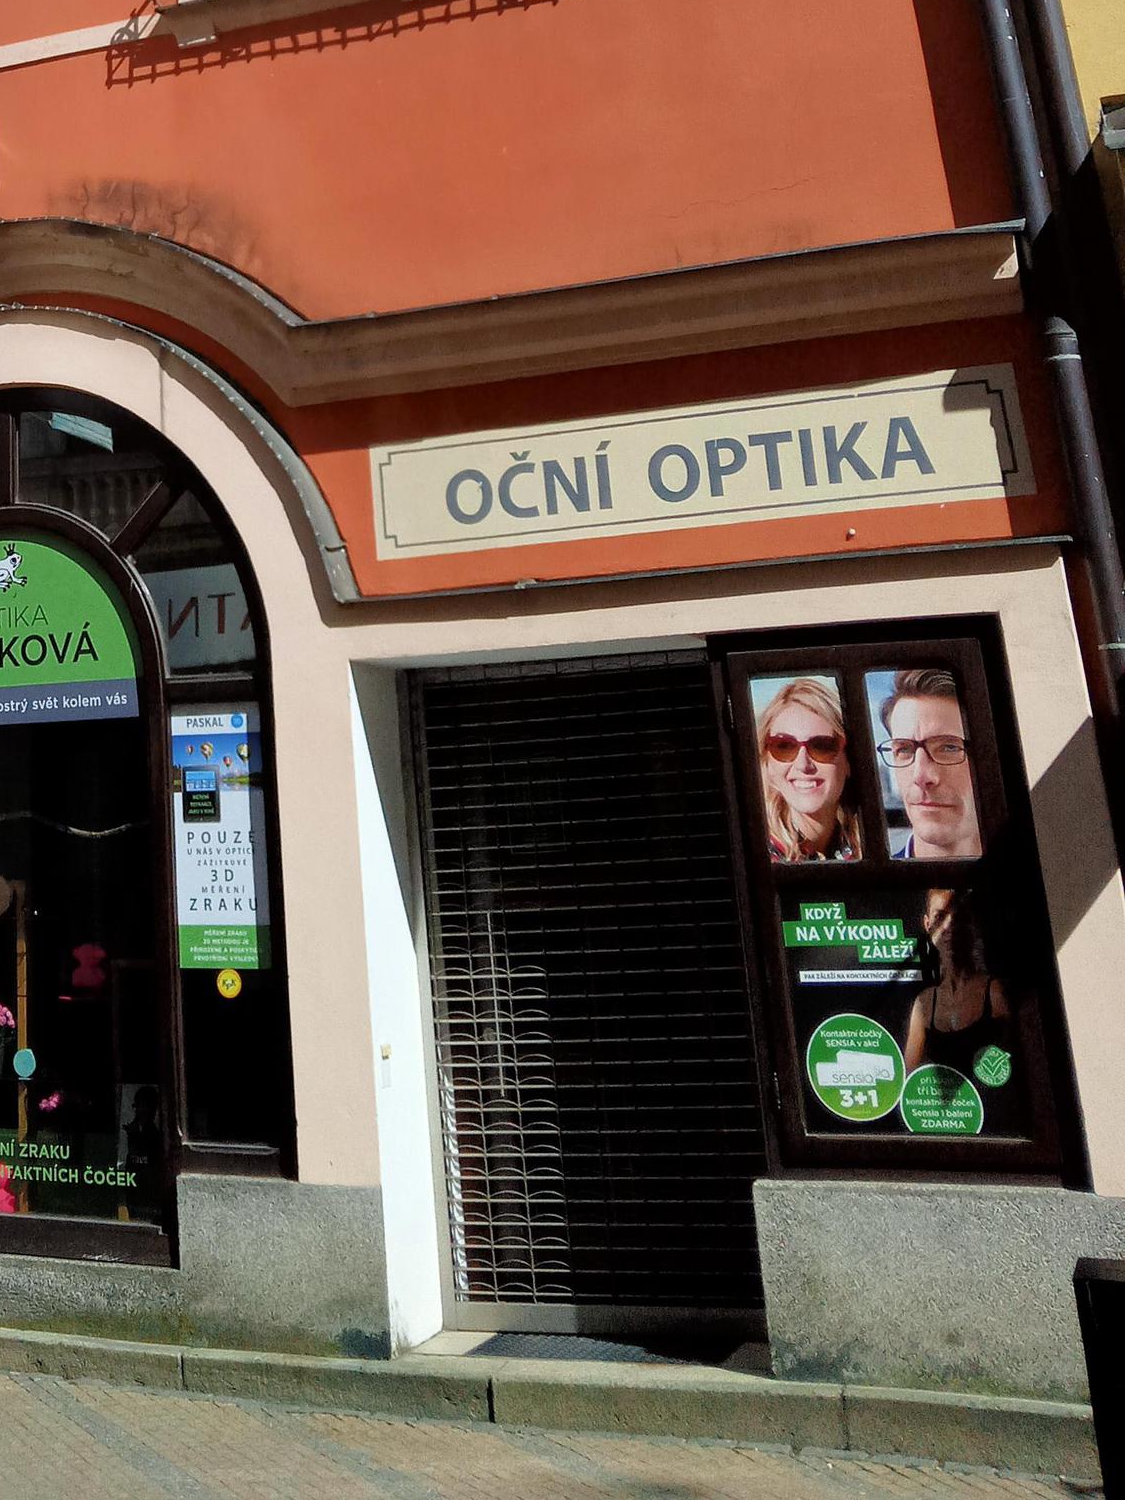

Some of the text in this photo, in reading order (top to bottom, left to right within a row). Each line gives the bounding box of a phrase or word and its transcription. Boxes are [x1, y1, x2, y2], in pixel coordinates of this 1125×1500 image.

[444, 415, 936, 525] OČNÍ OPTIKA
[32, 697, 59, 710] svět
[63, 693, 102, 708] kolem
[106, 692, 128, 706] vás
[186, 717, 224, 728] PASKAL
[187, 831, 257, 844] POUZE
[189, 898, 258, 911] ZRAKU
[804, 902, 842, 920] KDYŽ
[795, 921, 898, 941] NA VÝKONU
[861, 940, 914, 959] ZÁLEŽÍ
[820, 1029, 883, 1038] Kontaktní čočky
[825, 1040, 856, 1048] SENSIA
[832, 1071, 874, 1084] sensia
[839, 1089, 879, 1108] 3+1
[921, 1119, 967, 1129] ZDARMA
[18, 1142, 71, 1160] ZRAKU
[83, 1165, 137, 1187] ČOČEK
